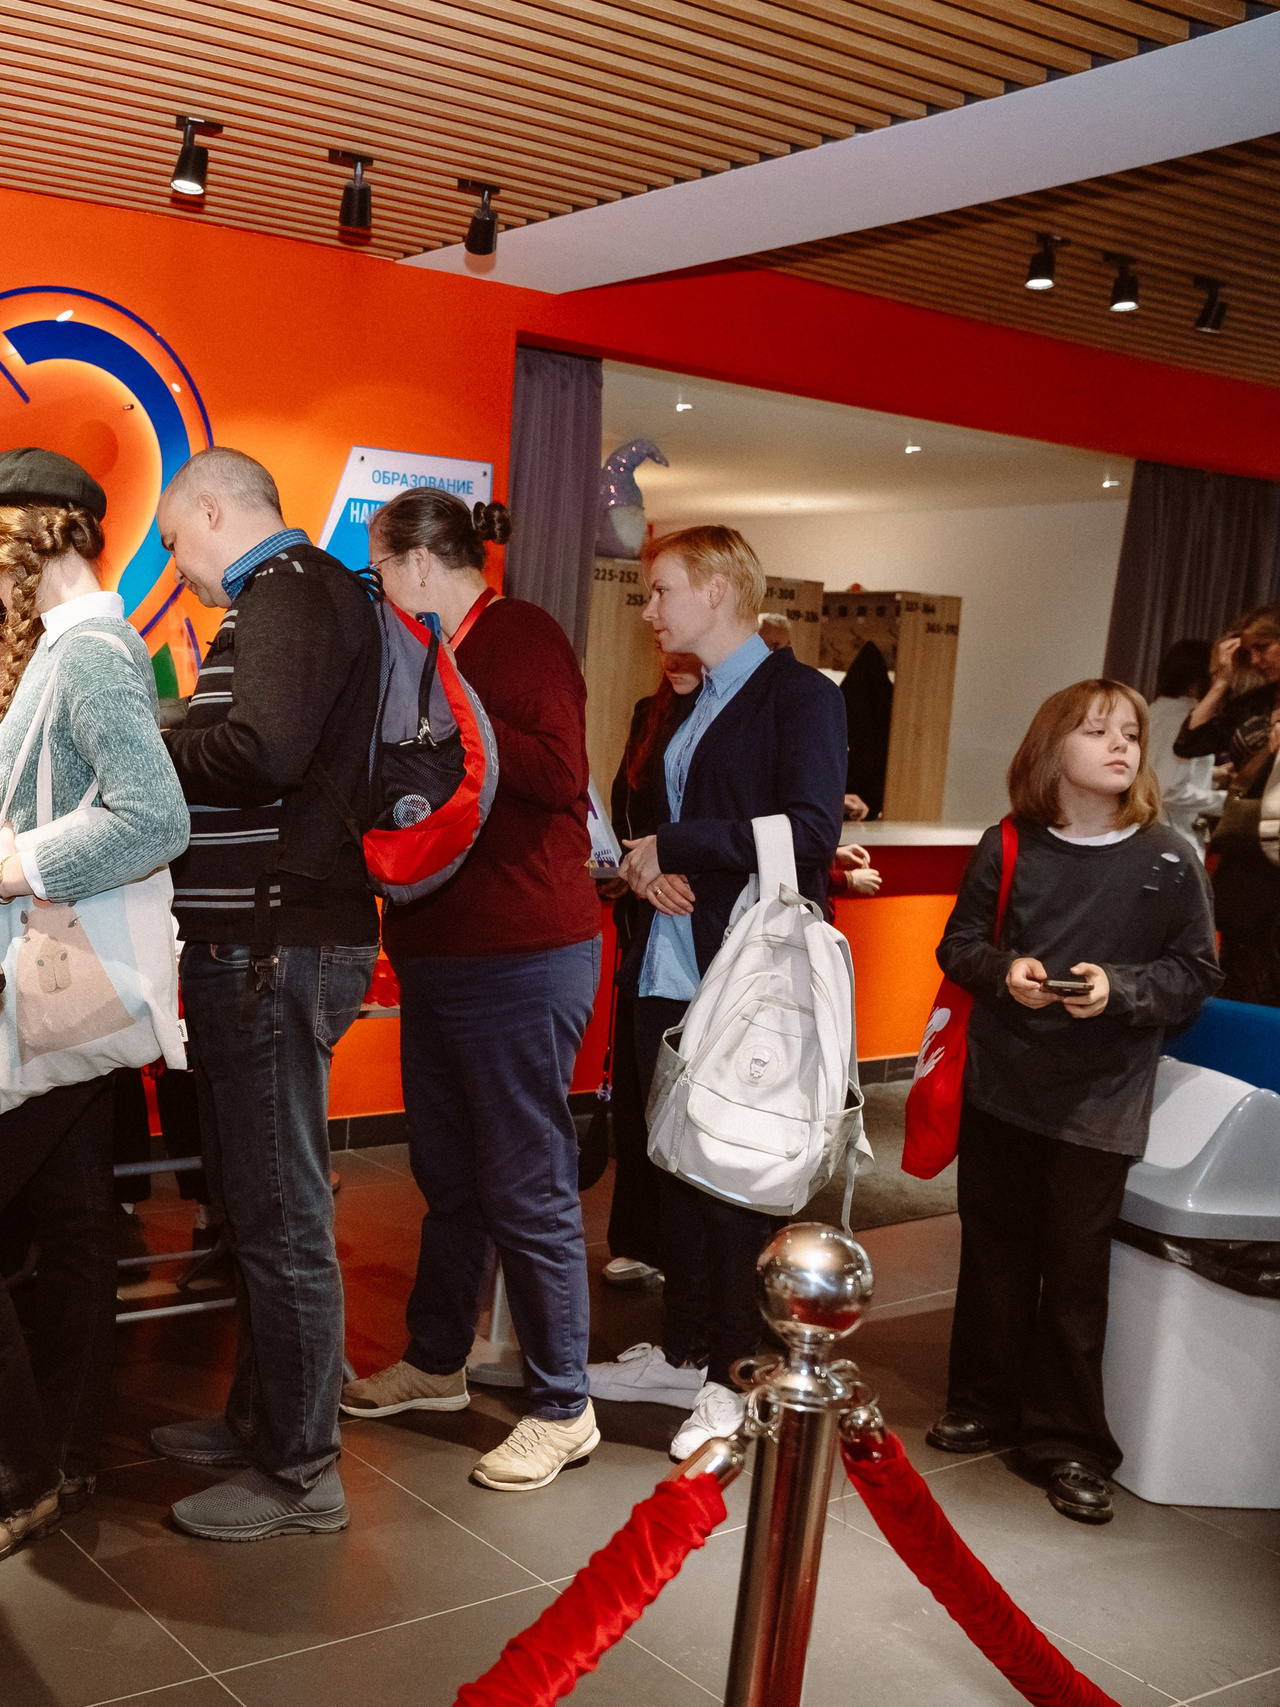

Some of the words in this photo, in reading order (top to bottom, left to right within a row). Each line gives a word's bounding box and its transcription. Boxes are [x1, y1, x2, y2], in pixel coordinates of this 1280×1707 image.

[371, 469, 474, 495] ОБРАЗОВАНИЕ
[593, 568, 639, 584] 225-252
[626, 593, 647, 606] 253-
